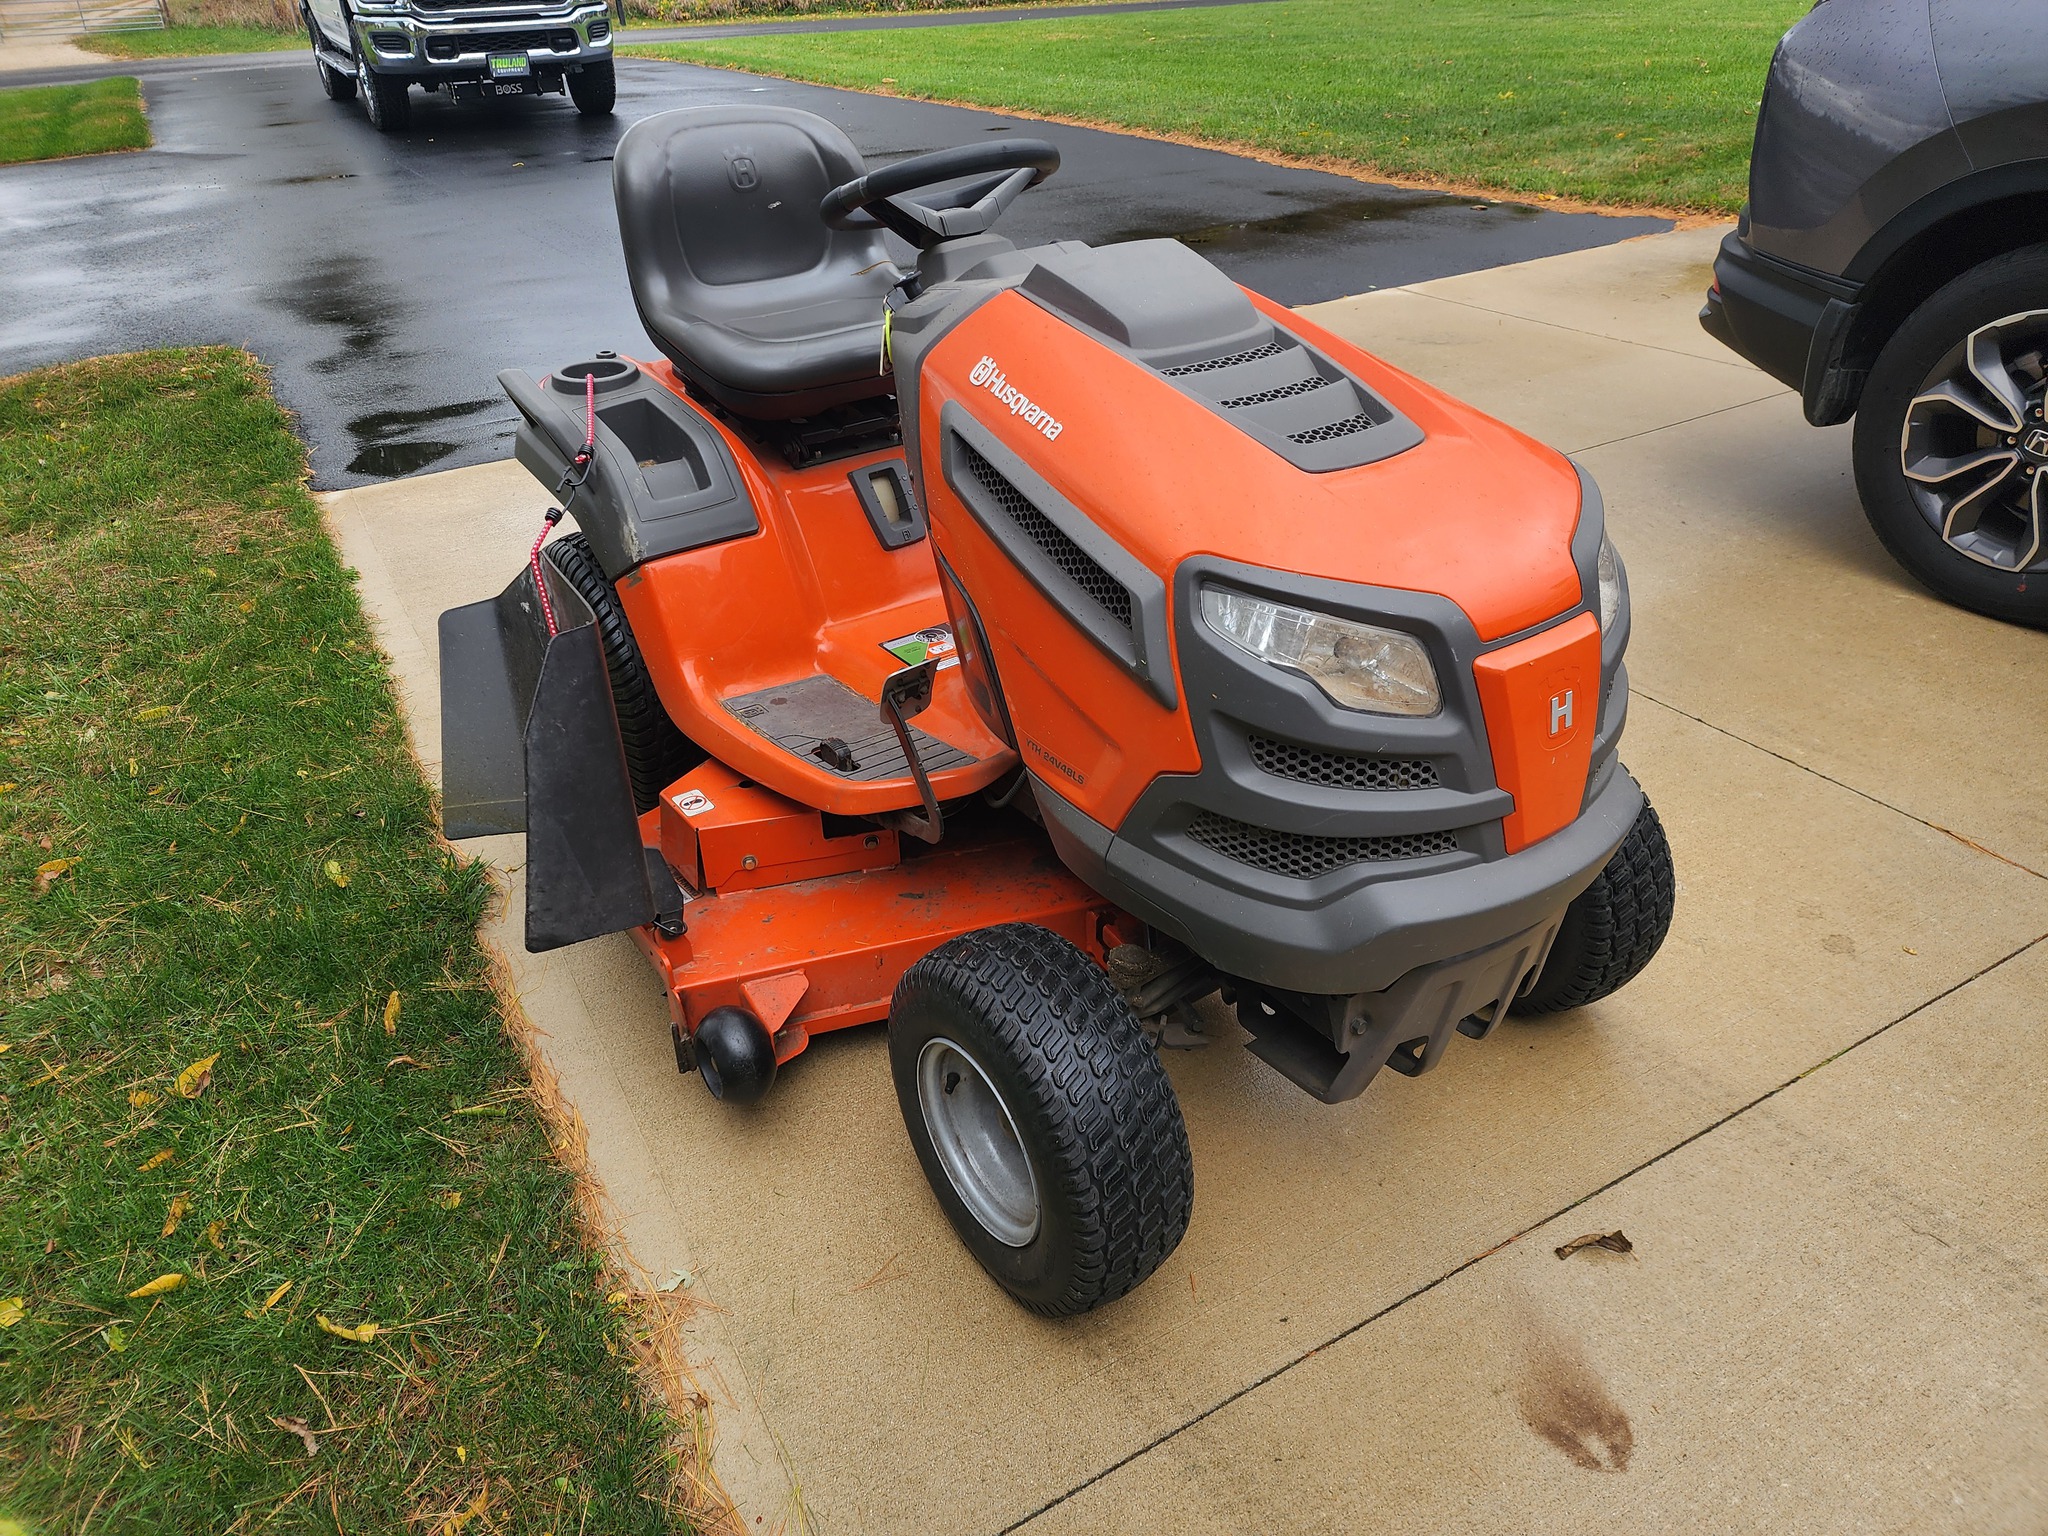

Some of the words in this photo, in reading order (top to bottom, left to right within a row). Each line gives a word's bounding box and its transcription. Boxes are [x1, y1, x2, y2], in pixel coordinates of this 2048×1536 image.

[491, 57, 527, 69] TRULAND
[495, 82, 523, 95] BOSS
[983, 367, 1063, 442] Husqvarna
[1551, 690, 1573, 735] H
[1026, 738, 1042, 756] YTH
